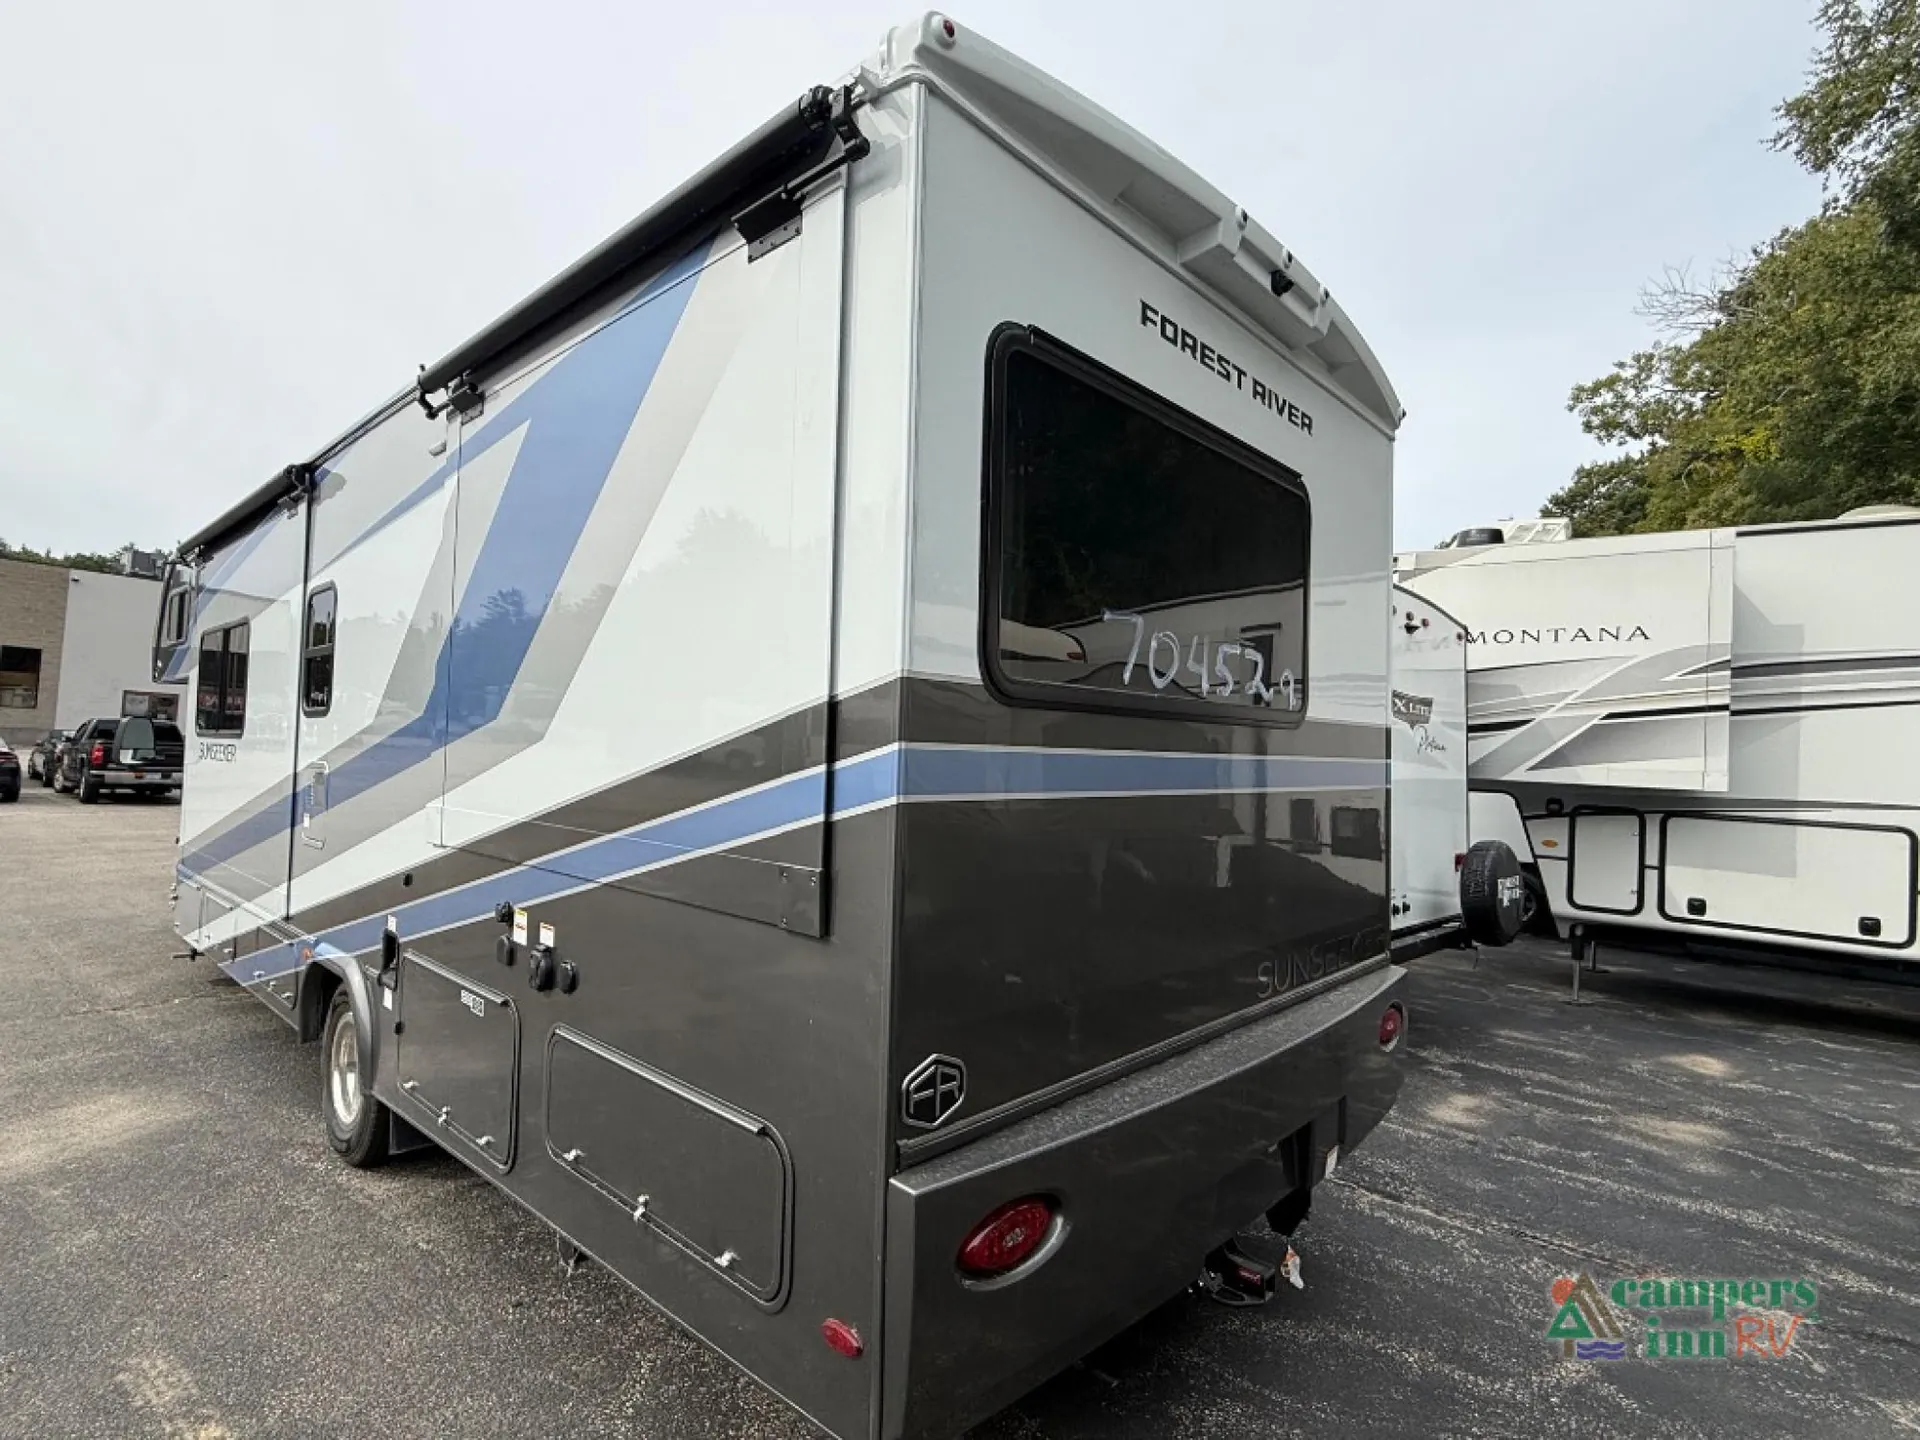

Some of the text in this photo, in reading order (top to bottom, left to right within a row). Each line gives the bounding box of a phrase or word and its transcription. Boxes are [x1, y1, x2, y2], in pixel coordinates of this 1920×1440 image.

[1139, 298, 1314, 438] FOREST RIVER
[1466, 626, 1652, 646] MONTANA
